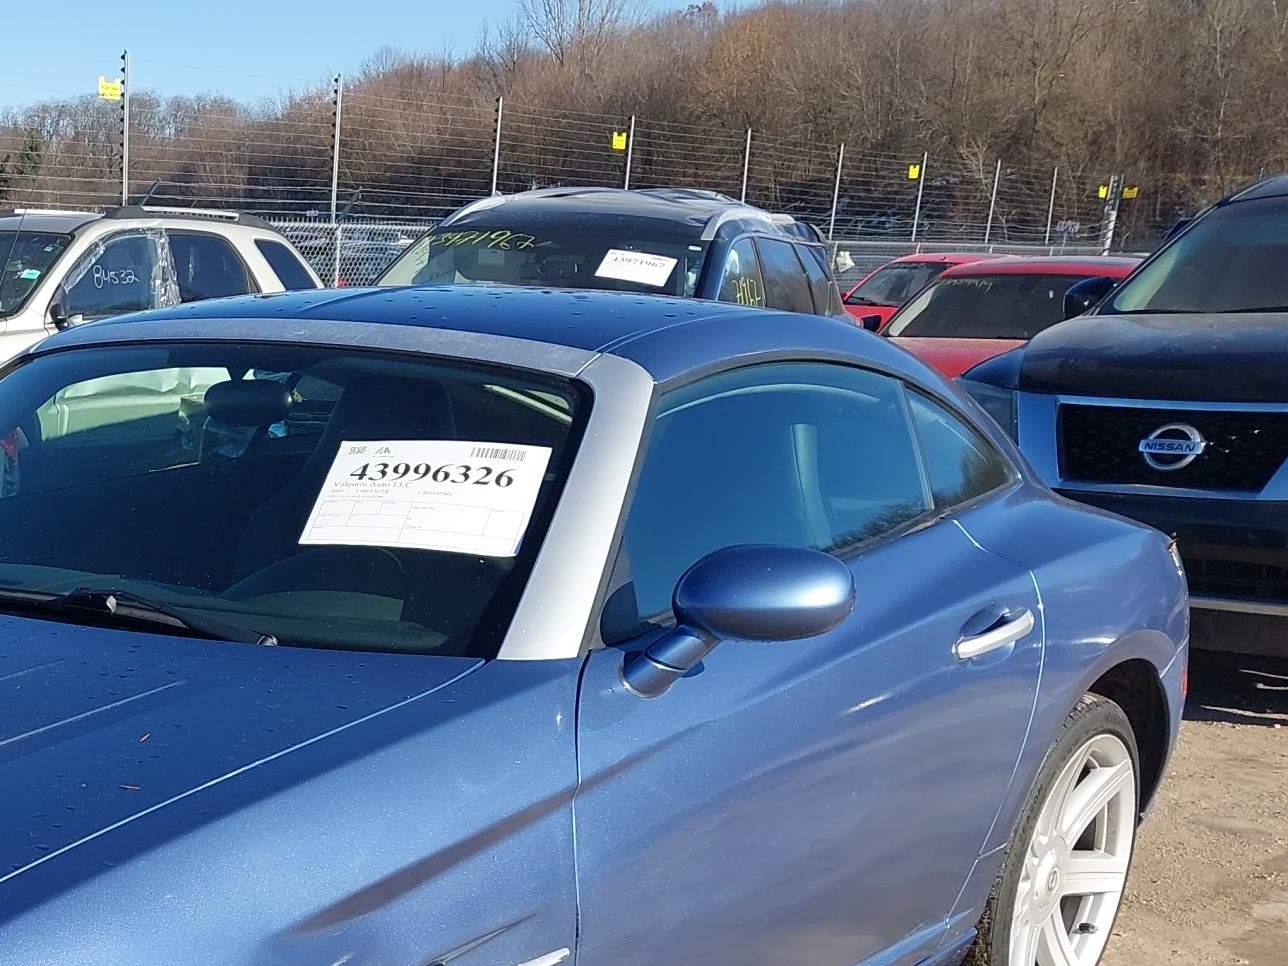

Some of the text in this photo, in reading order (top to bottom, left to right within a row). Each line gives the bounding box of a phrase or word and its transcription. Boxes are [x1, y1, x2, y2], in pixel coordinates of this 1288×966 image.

[93, 264, 140, 289] 84532
[1144, 441, 1196, 452] NISSAN
[350, 463, 516, 488] 43996326
